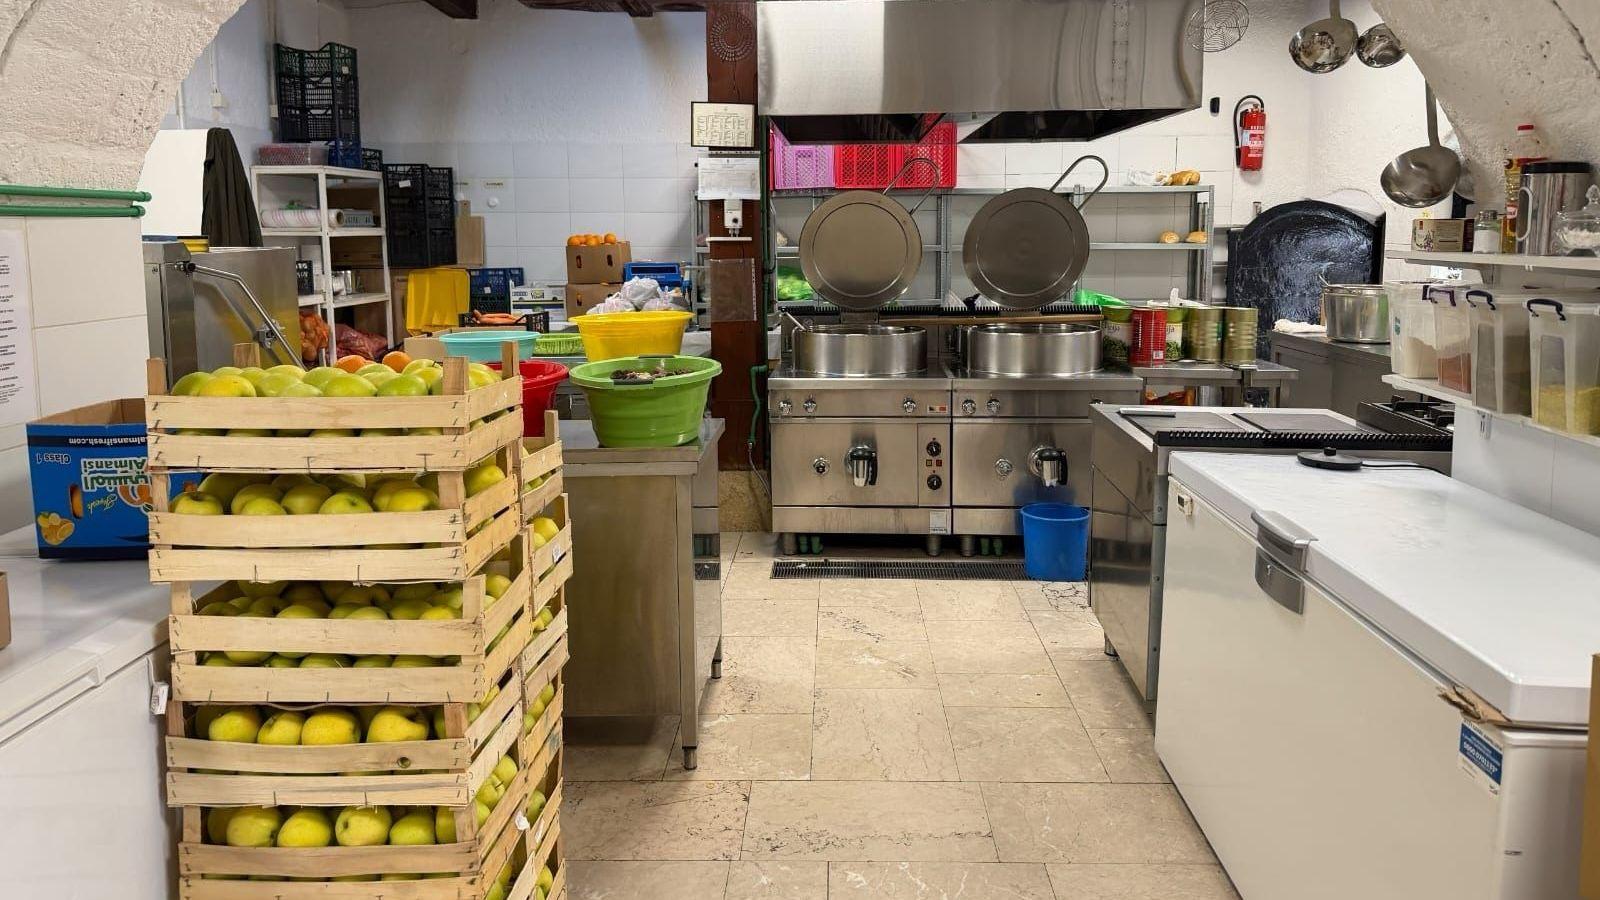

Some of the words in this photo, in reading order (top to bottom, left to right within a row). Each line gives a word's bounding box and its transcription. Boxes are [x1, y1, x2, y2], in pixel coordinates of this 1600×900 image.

[36, 453, 42, 464] 1
[43, 453, 71, 464] Class
[83, 459, 147, 473] Almansi
